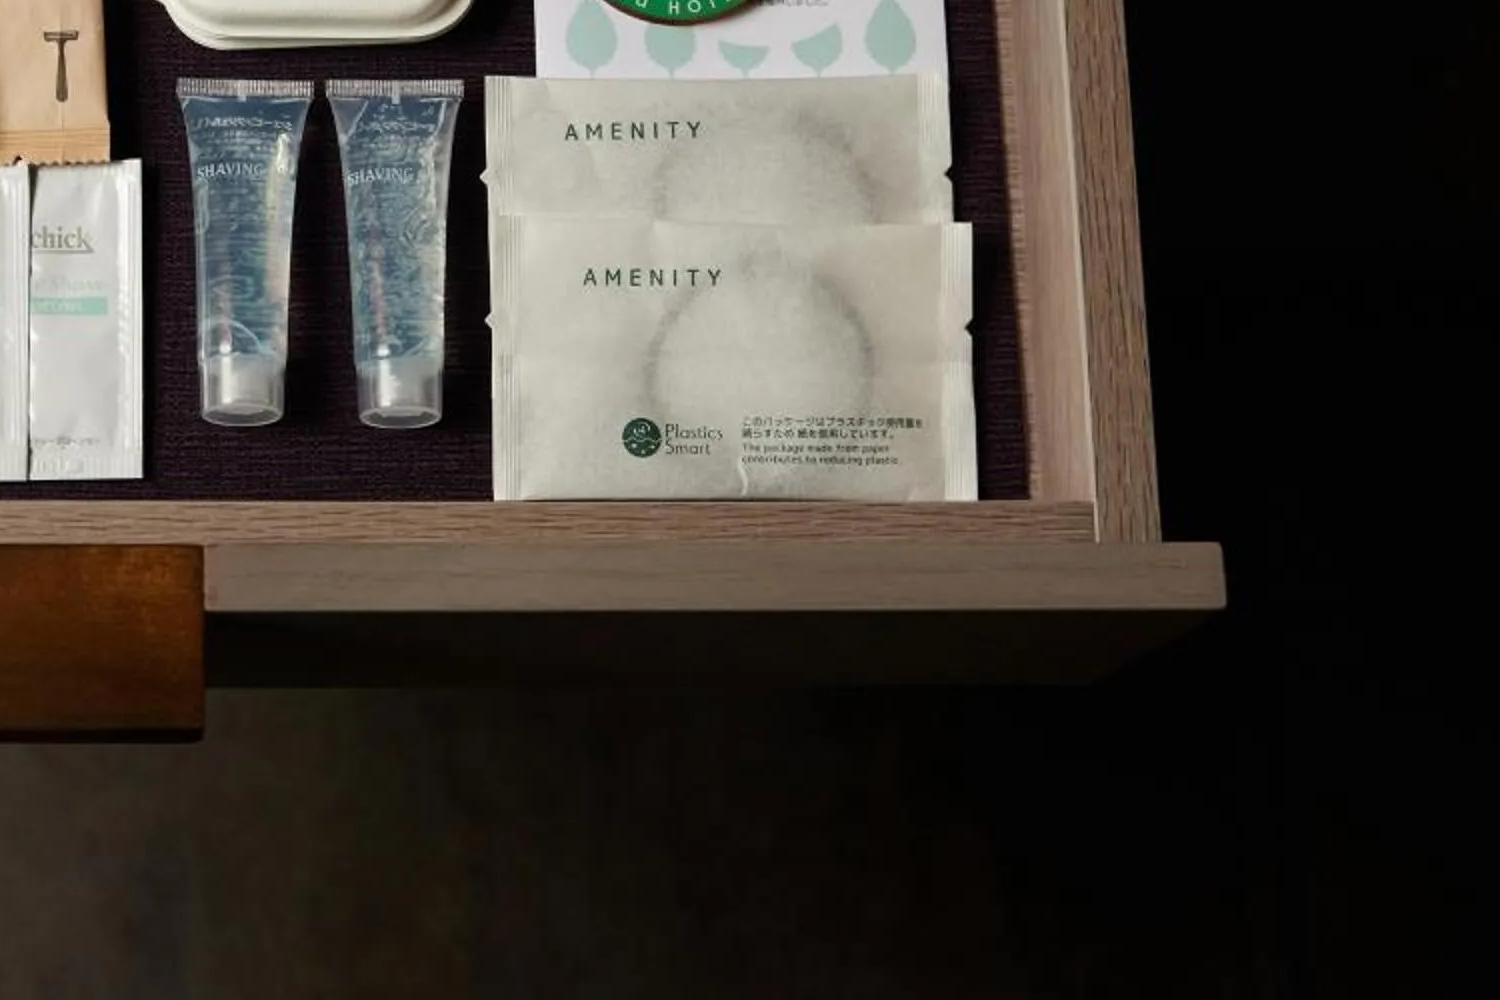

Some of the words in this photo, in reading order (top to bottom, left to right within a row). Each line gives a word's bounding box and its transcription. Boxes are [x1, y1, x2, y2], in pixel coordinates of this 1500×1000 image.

[564, 120, 703, 143] AMENITY
[196, 163, 265, 181] SHAVING
[346, 166, 414, 187] SHAVING
[583, 268, 723, 288] AMENITY
[664, 423, 725, 441] Plastics
[664, 441, 712, 457] Smart
